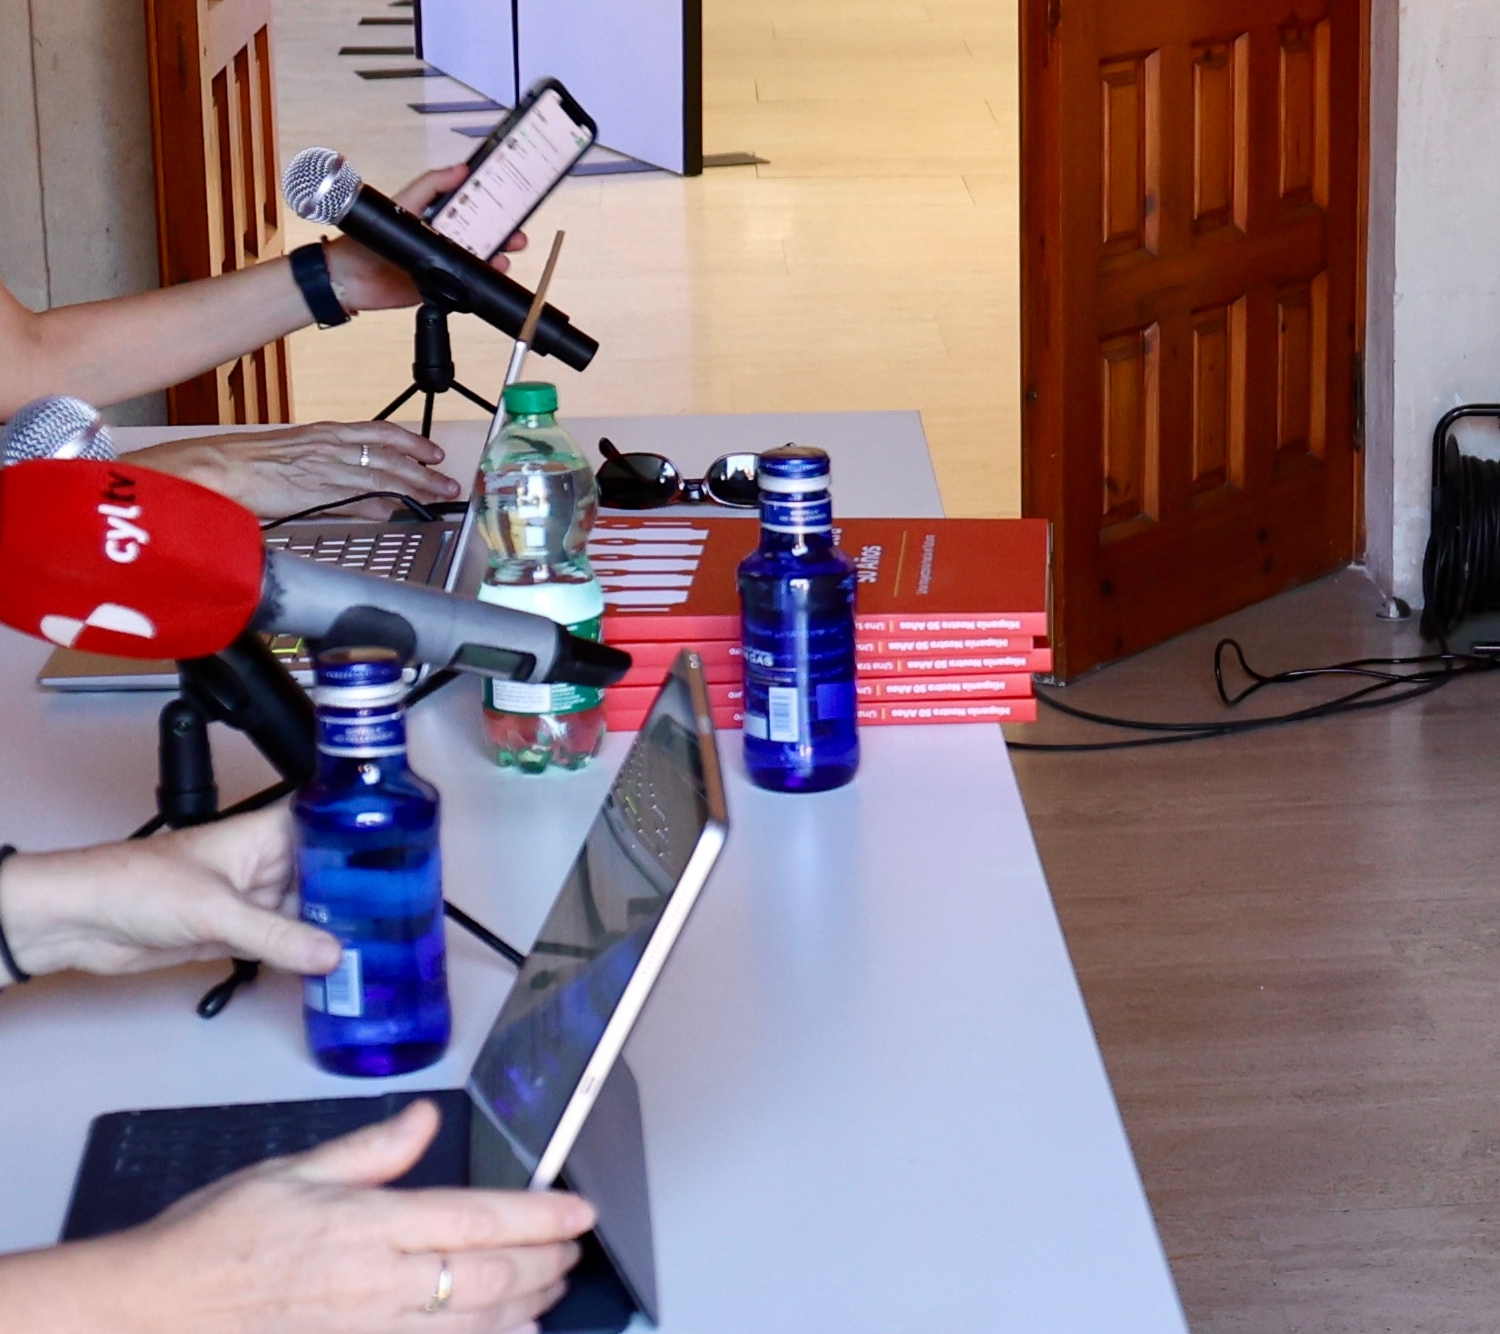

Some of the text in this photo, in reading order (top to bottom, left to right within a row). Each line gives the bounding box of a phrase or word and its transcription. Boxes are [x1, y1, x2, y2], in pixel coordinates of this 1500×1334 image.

[97, 471, 151, 564] cyltv
[854, 545, 882, 570] Años
[899, 621, 925, 631] Años
[926, 621, 941, 630] 50
[941, 620, 975, 630] Nostra
[976, 619, 1021, 630] Hispania
[888, 642, 914, 652] Años
[915, 641, 929, 651] 50
[930, 640, 964, 649] Nostra
[964, 638, 1009, 649] Hispania
[907, 660, 933, 670] Años
[934, 659, 947, 669] 50
[948, 658, 982, 668] Nostra
[983, 656, 1027, 667] Hispania
[857, 680, 1006, 695] Hispania Nostra 50 Años Un
[891, 709, 916, 719] Años
[917, 708, 932, 718] 50
[932, 708, 966, 717] Nostra
[967, 705, 1011, 716] Hispania
